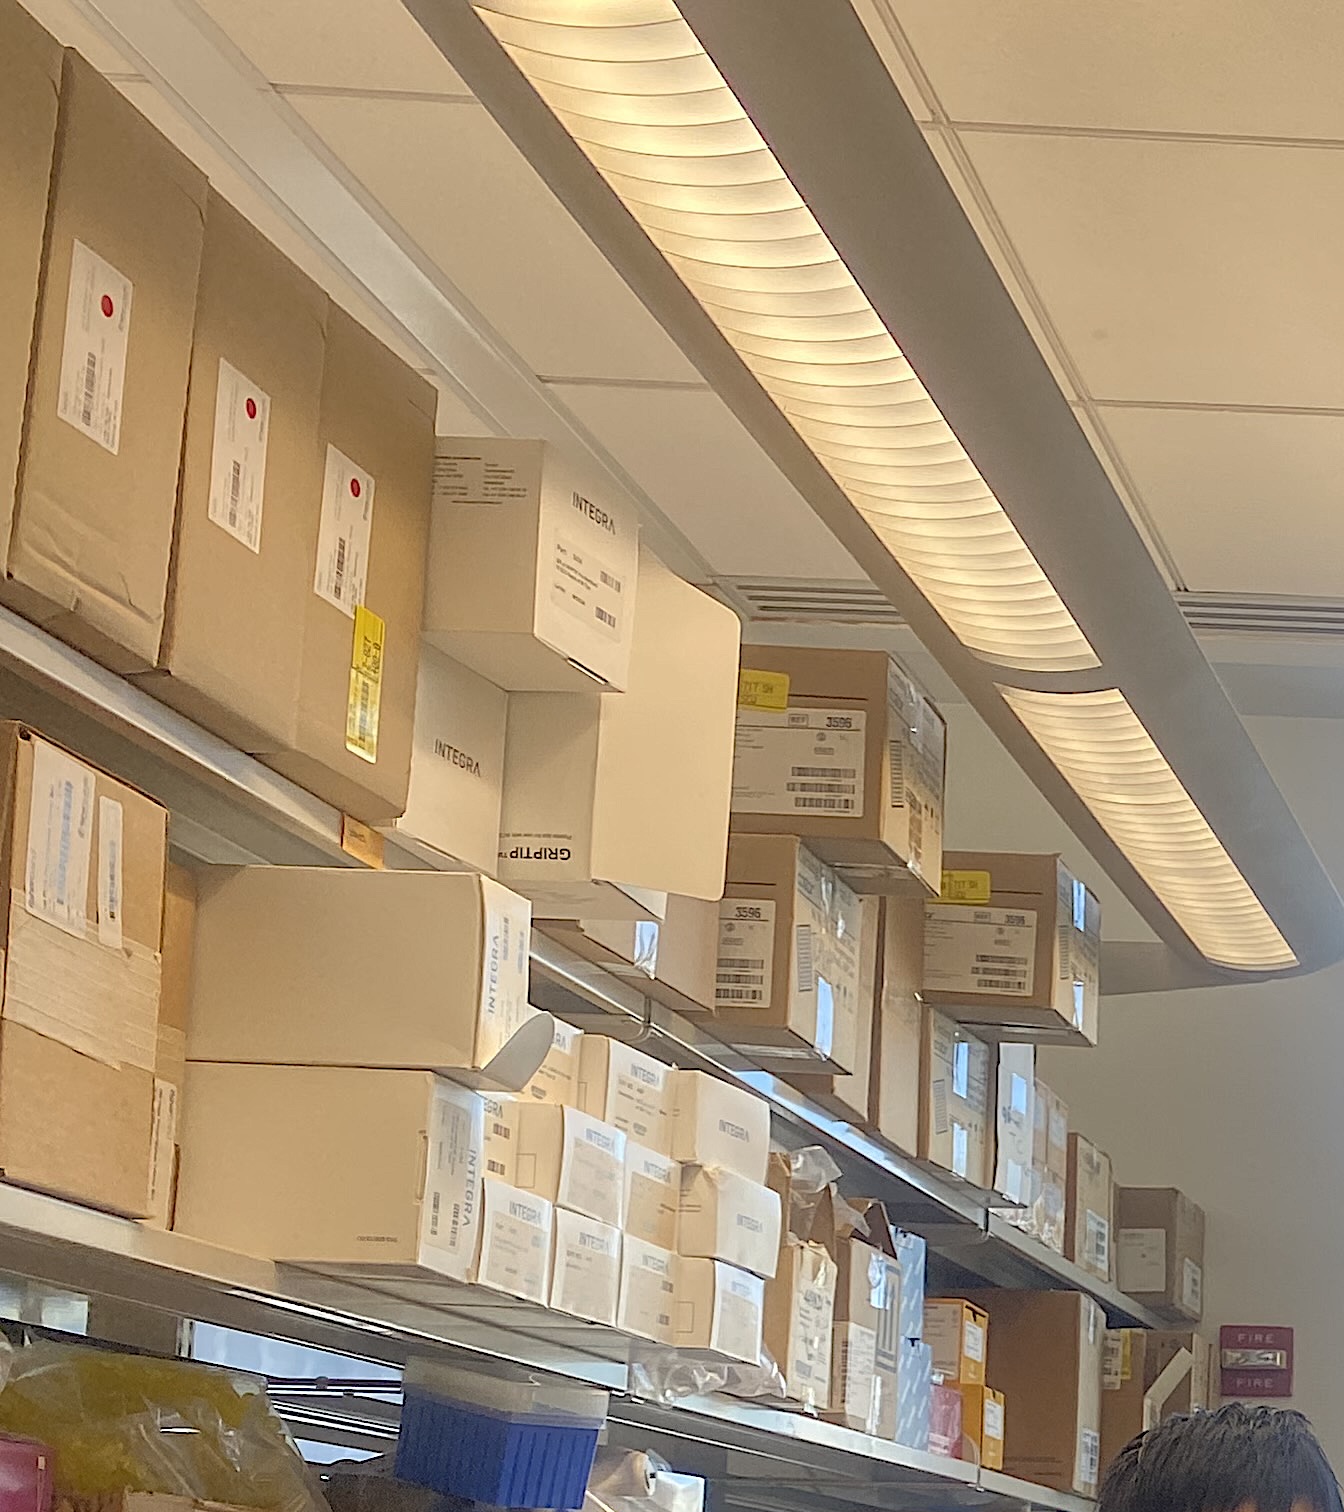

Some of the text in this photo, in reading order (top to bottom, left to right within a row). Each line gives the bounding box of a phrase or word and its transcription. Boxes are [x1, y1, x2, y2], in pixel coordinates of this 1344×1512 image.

[572, 491, 616, 535] INTEGRA
[826, 716, 852, 728] 3596
[434, 738, 481, 777] INTEGRA
[508, 847, 571, 861] GRIPTIP
[735, 907, 761, 918] 3596
[487, 935, 500, 1014] INTEGRA
[630, 1063, 660, 1087] INTEGRA
[719, 1119, 750, 1143] INTEGRA
[463, 1148, 477, 1228] INTEGRA
[509, 1200, 542, 1224] INTEGRA
[1238, 1333, 1275, 1344] FIRE
[1236, 1378, 1273, 1389] FIRE
